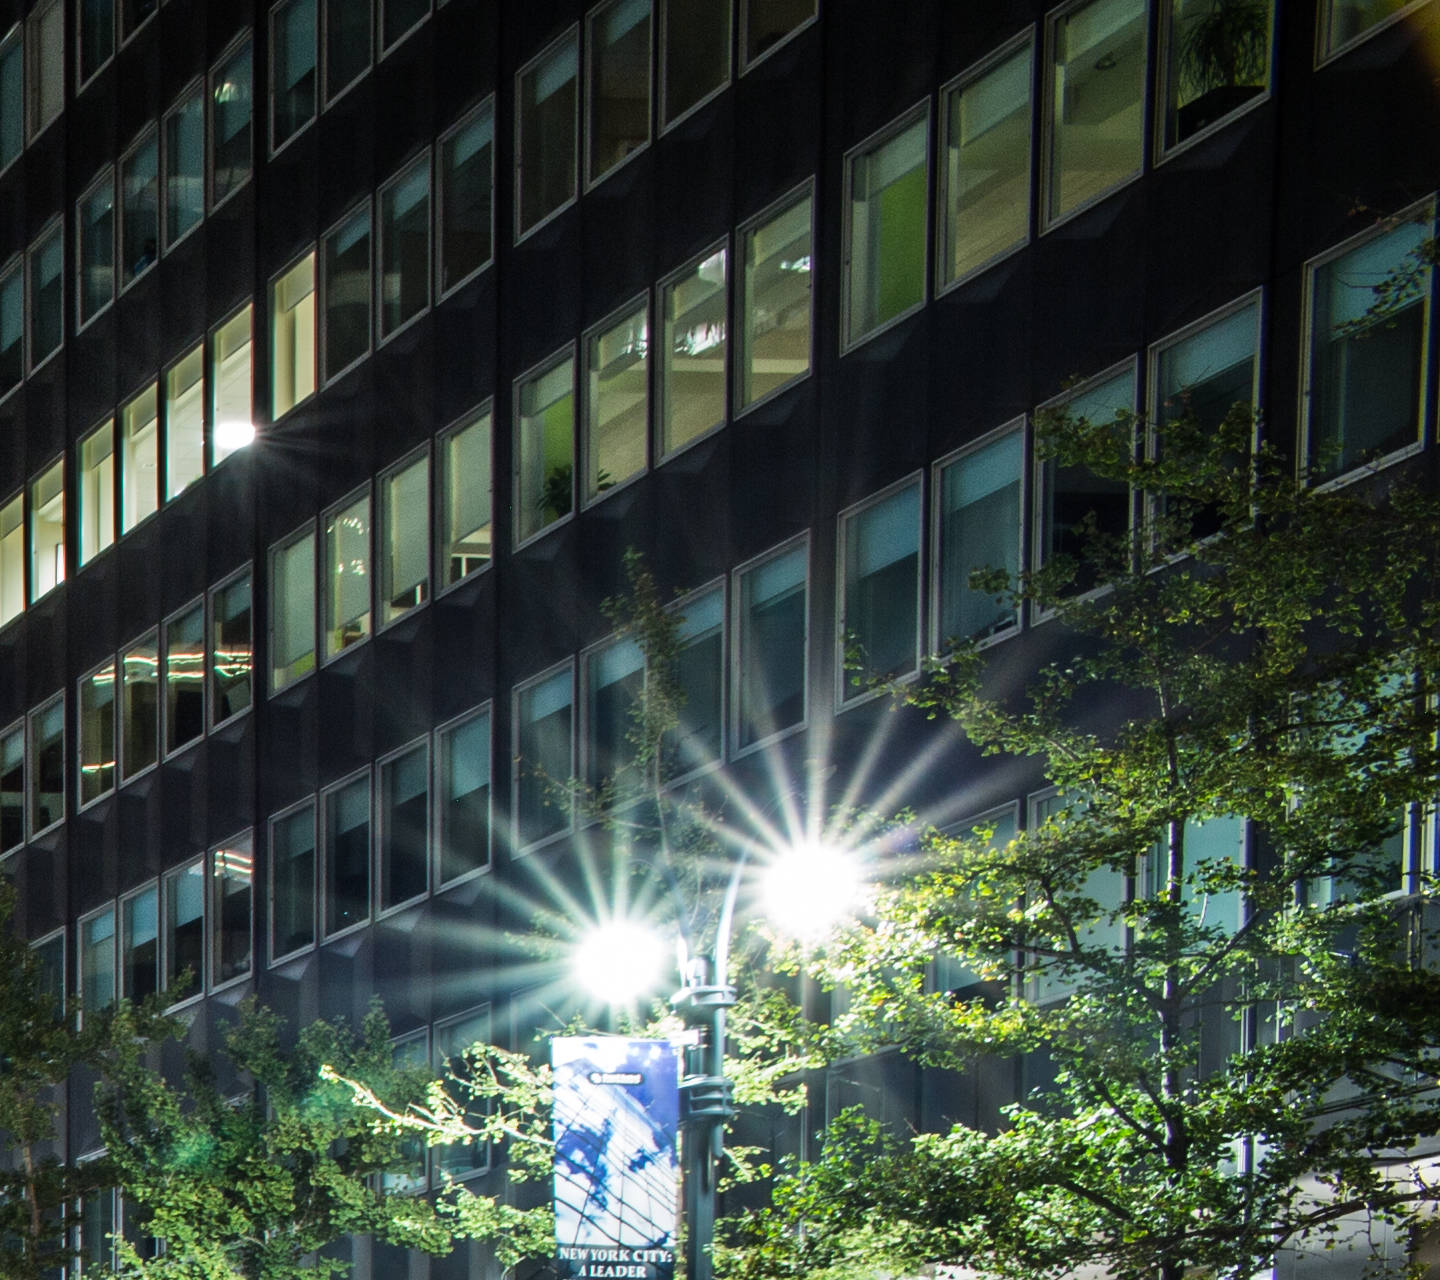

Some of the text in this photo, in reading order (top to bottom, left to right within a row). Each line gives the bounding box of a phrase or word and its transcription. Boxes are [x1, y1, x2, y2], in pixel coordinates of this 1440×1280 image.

[558, 1247, 673, 1263] NEW YORK CITY:
[578, 1264, 647, 1279] A LEADER
